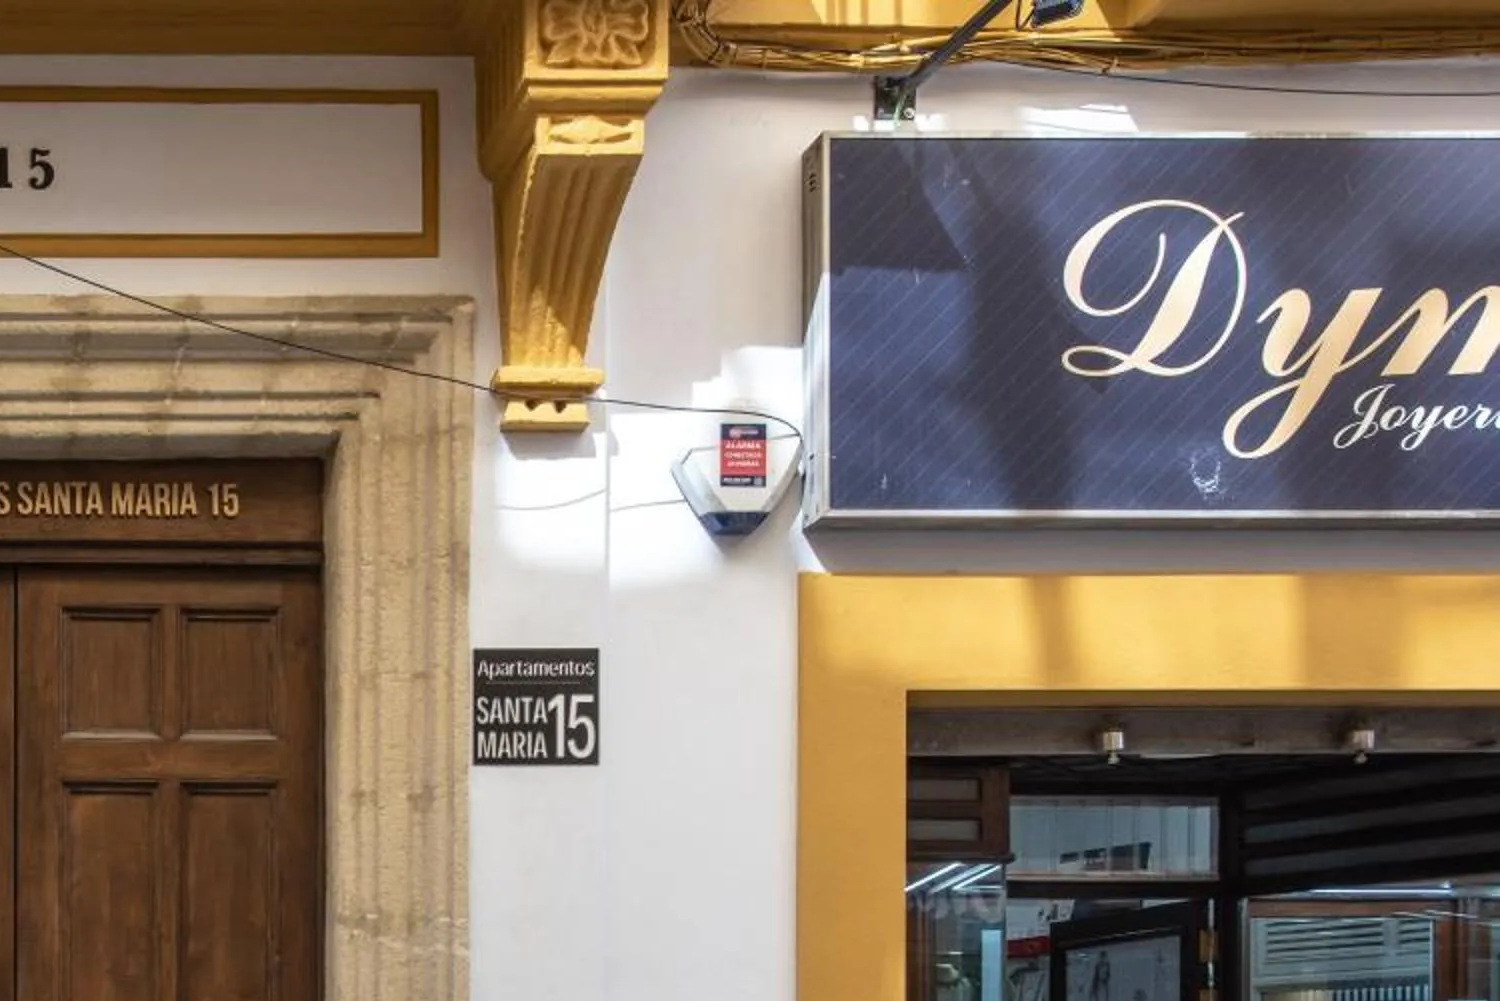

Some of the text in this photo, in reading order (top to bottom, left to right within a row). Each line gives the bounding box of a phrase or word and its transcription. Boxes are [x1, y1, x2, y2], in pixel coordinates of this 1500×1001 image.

[1333, 383, 1500, 451] Joyer
[17, 481, 103, 516] SANTA
[111, 482, 197, 517] MARIA
[207, 483, 240, 517] 15
[477, 660, 595, 680] Apartamentos
[476, 693, 596, 759] SANTA 15
[477, 731, 548, 759] MARIA
